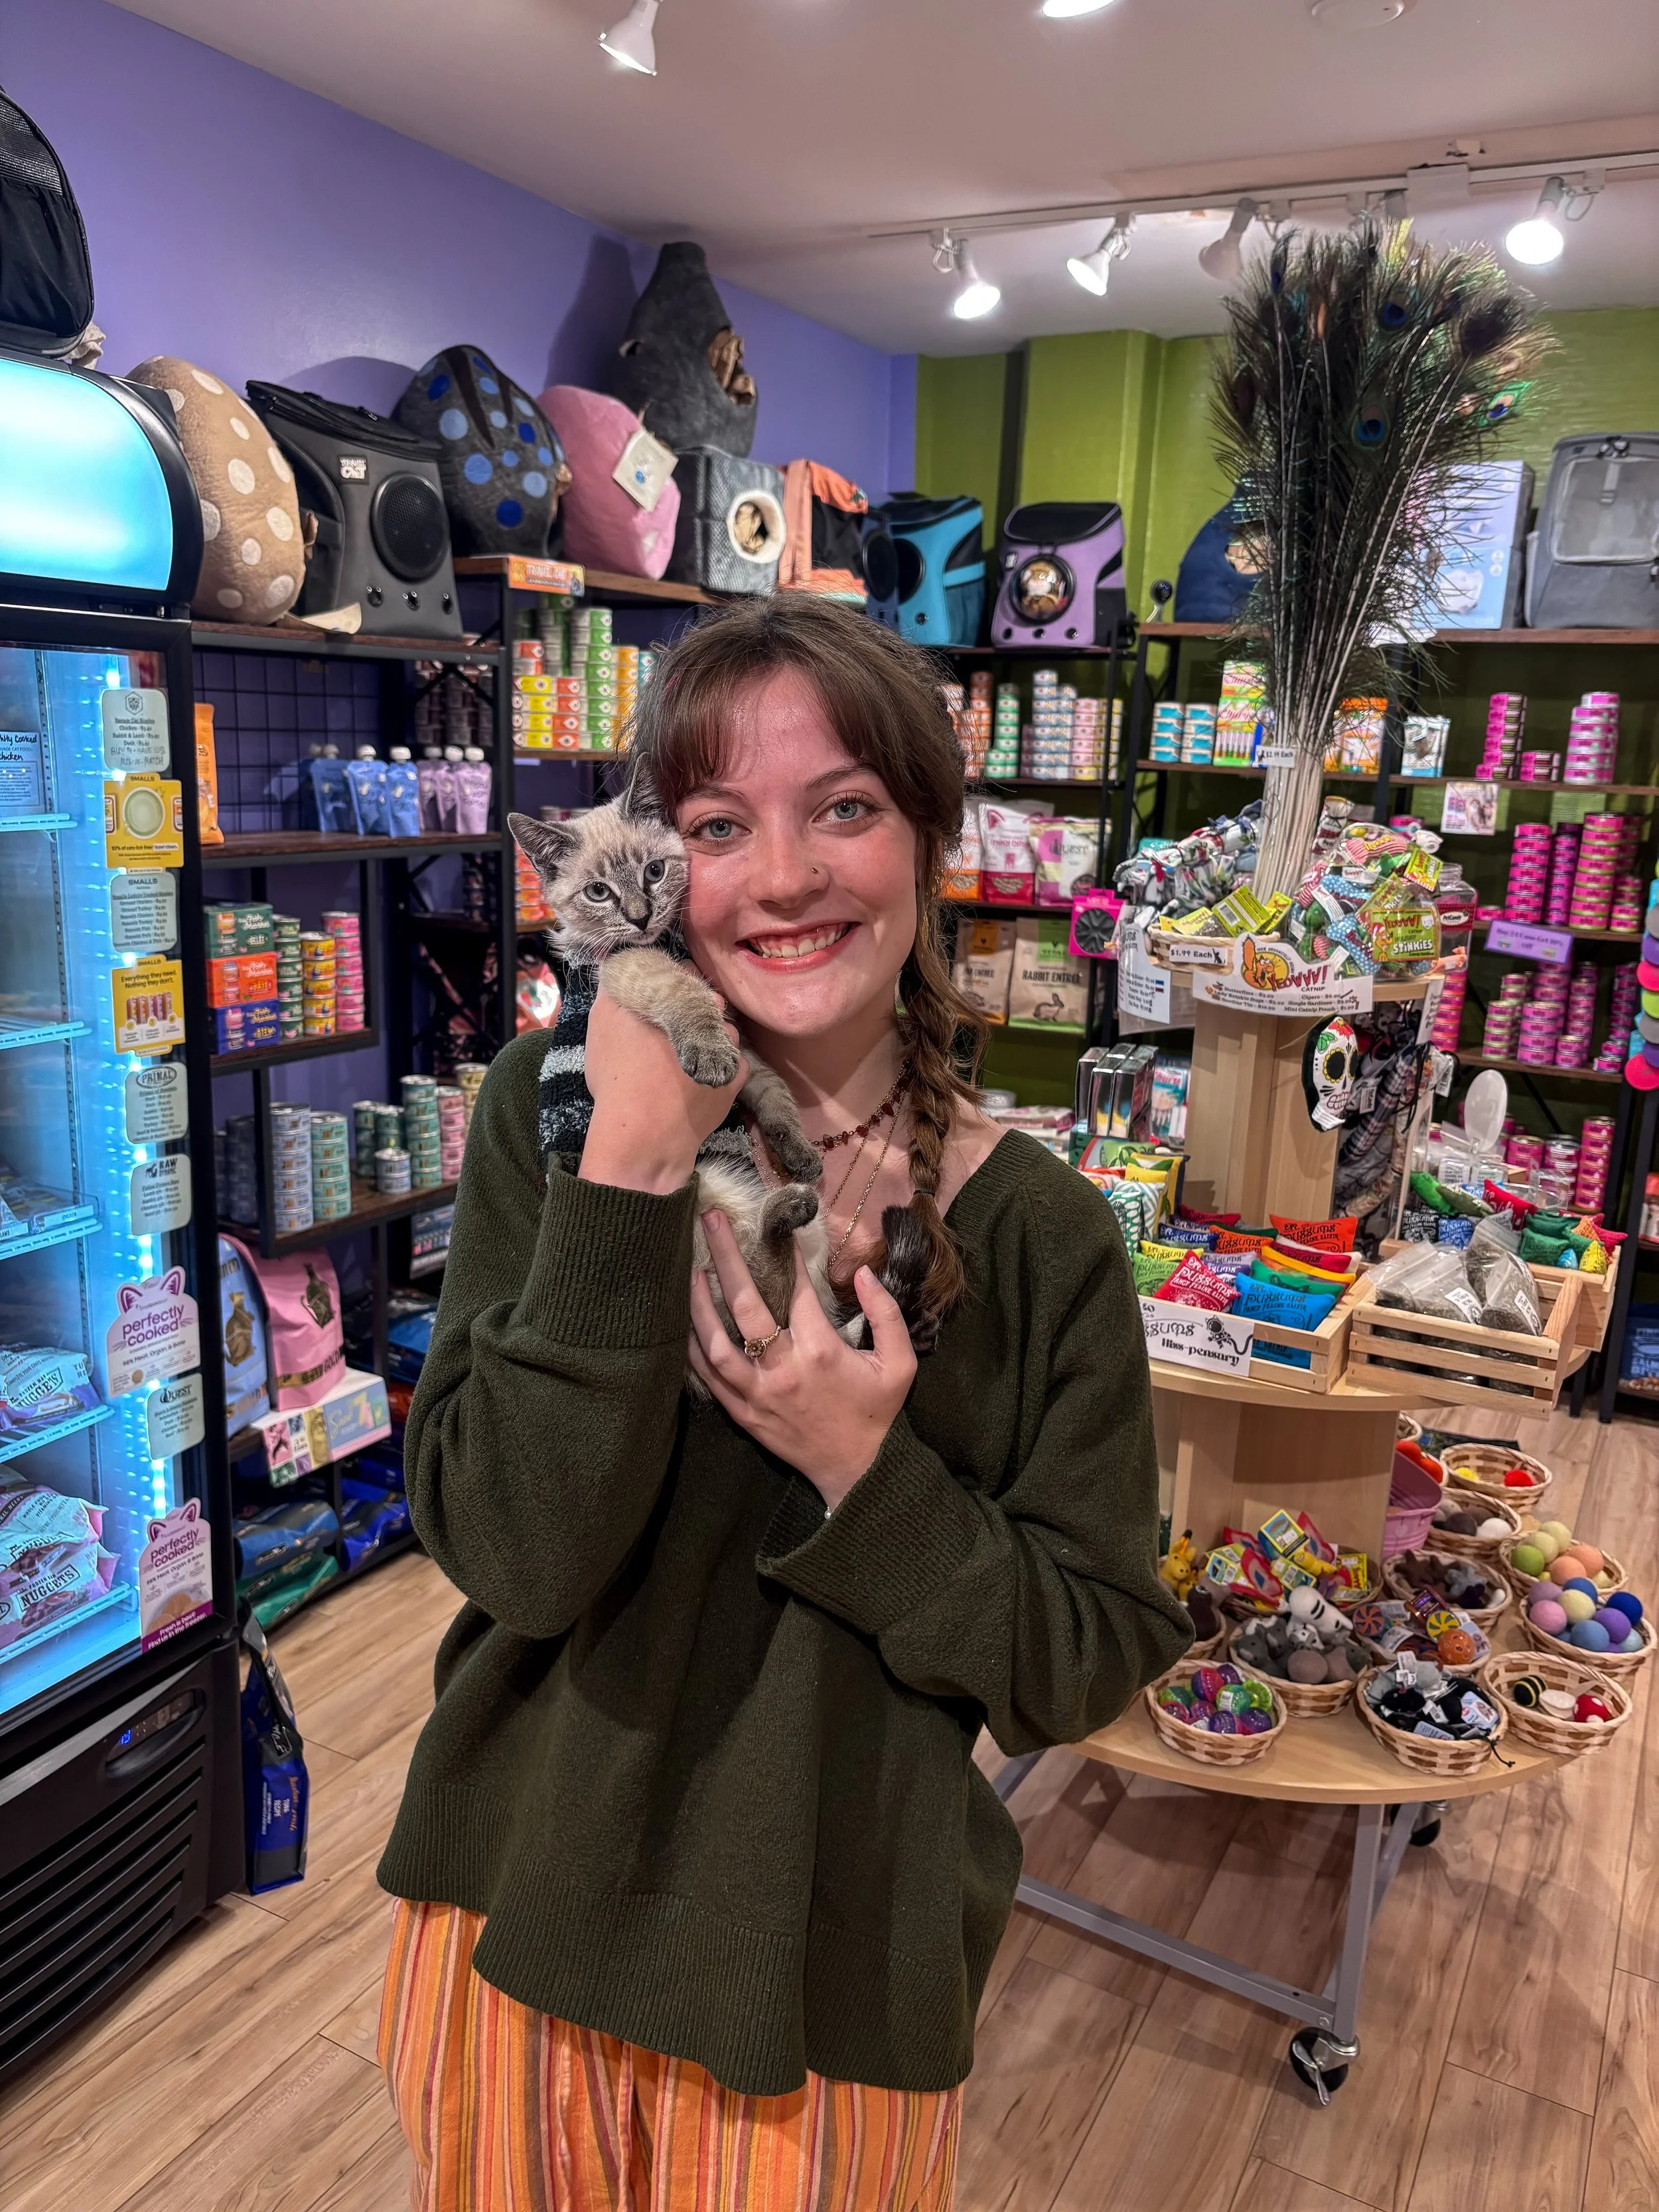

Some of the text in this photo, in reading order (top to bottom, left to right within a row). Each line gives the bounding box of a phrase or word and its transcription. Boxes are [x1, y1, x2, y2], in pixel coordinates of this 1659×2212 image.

[121, 973, 150, 983] Everything
[1022, 970, 1050, 980] RABBIT
[141, 1070, 173, 1084] PRIMAL
[159, 1157, 178, 1169] RAW
[1171, 1276, 1191, 1288] FANCY
[1262, 1302, 1285, 1312] FELINE
[122, 1304, 184, 1340] perfectly
[127, 1318, 179, 1347] cooked
[160, 1383, 192, 1403] QUEST
[151, 1528, 200, 1563] perfectly
[155, 1541, 194, 1568] cooked
[21, 1570, 76, 1607] NUGGETS
[147, 1637, 162, 1650] Find
[161, 1632, 169, 1643] us
[175, 1624, 186, 1636] the
